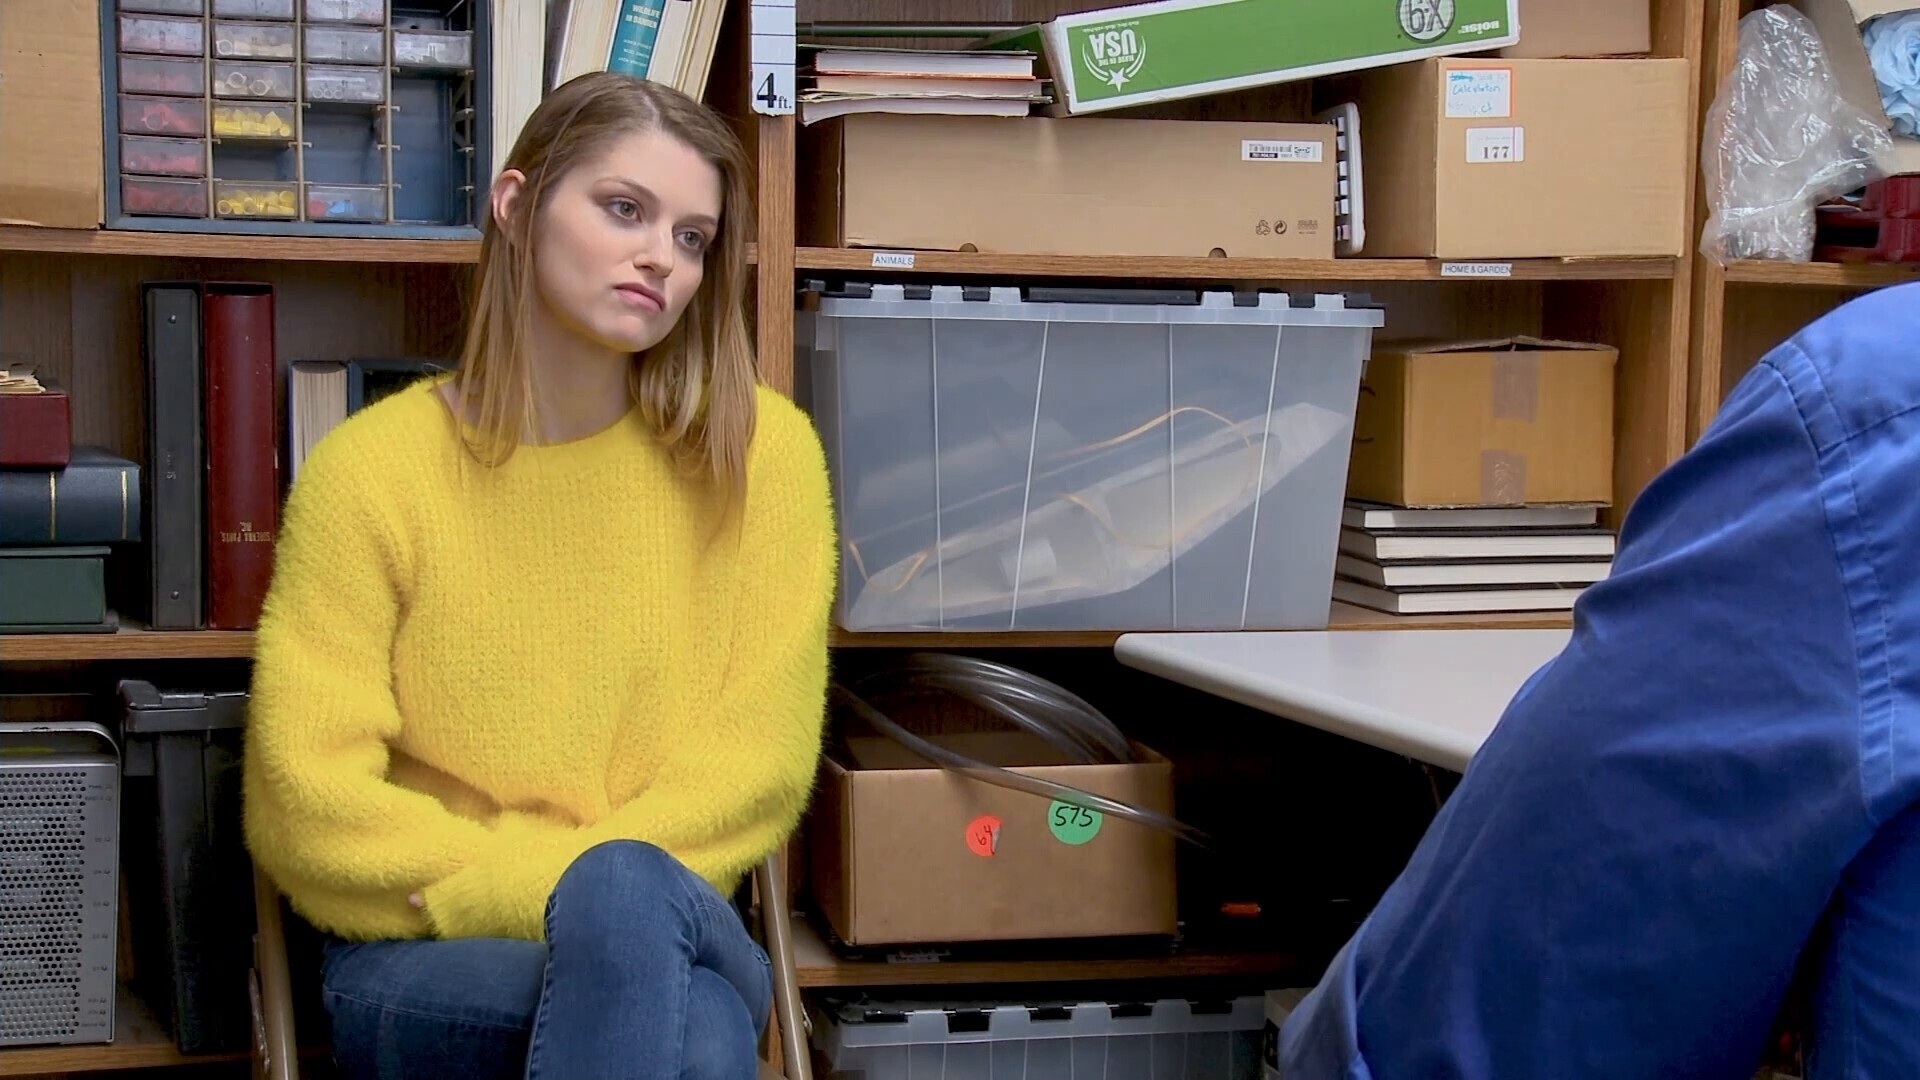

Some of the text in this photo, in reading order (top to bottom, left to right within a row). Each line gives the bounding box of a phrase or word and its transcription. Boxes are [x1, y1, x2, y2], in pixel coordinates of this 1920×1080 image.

[1089, 29, 1137, 59] USA
[1483, 146, 1510, 159] 177
[875, 256, 914, 265] ANIMALS
[1444, 265, 1470, 274] HOME
[1470, 265, 1477, 274] &
[1055, 806, 1093, 827] 575
